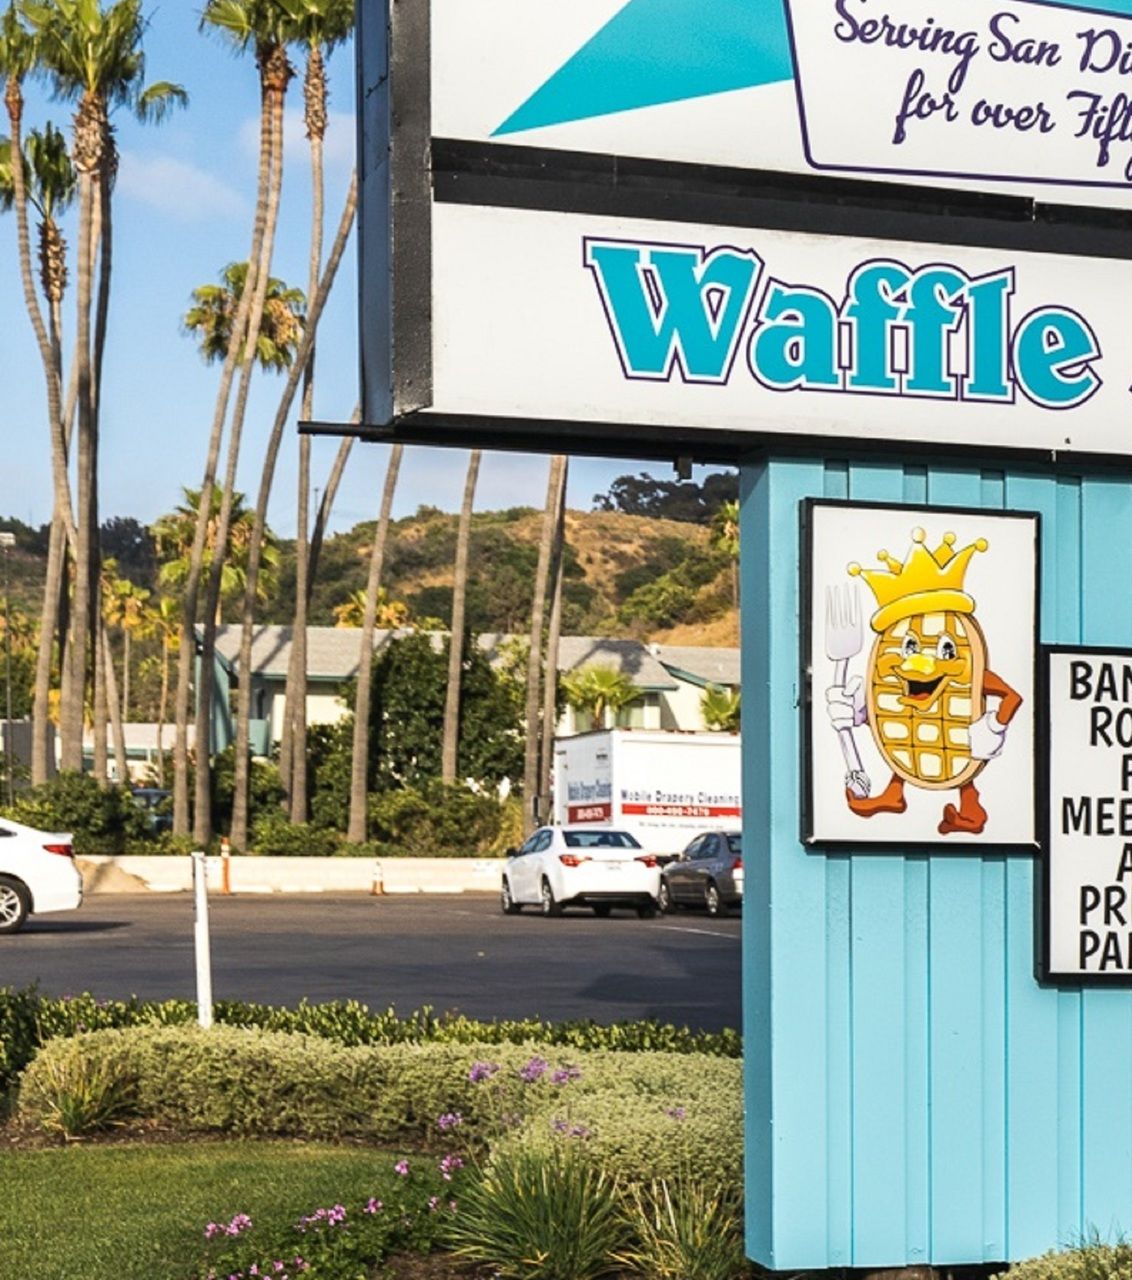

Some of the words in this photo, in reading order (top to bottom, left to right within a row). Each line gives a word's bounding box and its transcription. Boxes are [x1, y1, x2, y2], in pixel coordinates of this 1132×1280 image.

[988, 12, 1062, 67] San
[892, 69, 958, 144] for
[971, 100, 1056, 133] over
[583, 236, 1102, 410] Waffle
[620, 789, 652, 801] Mobile
[655, 790, 694, 805] Drapery
